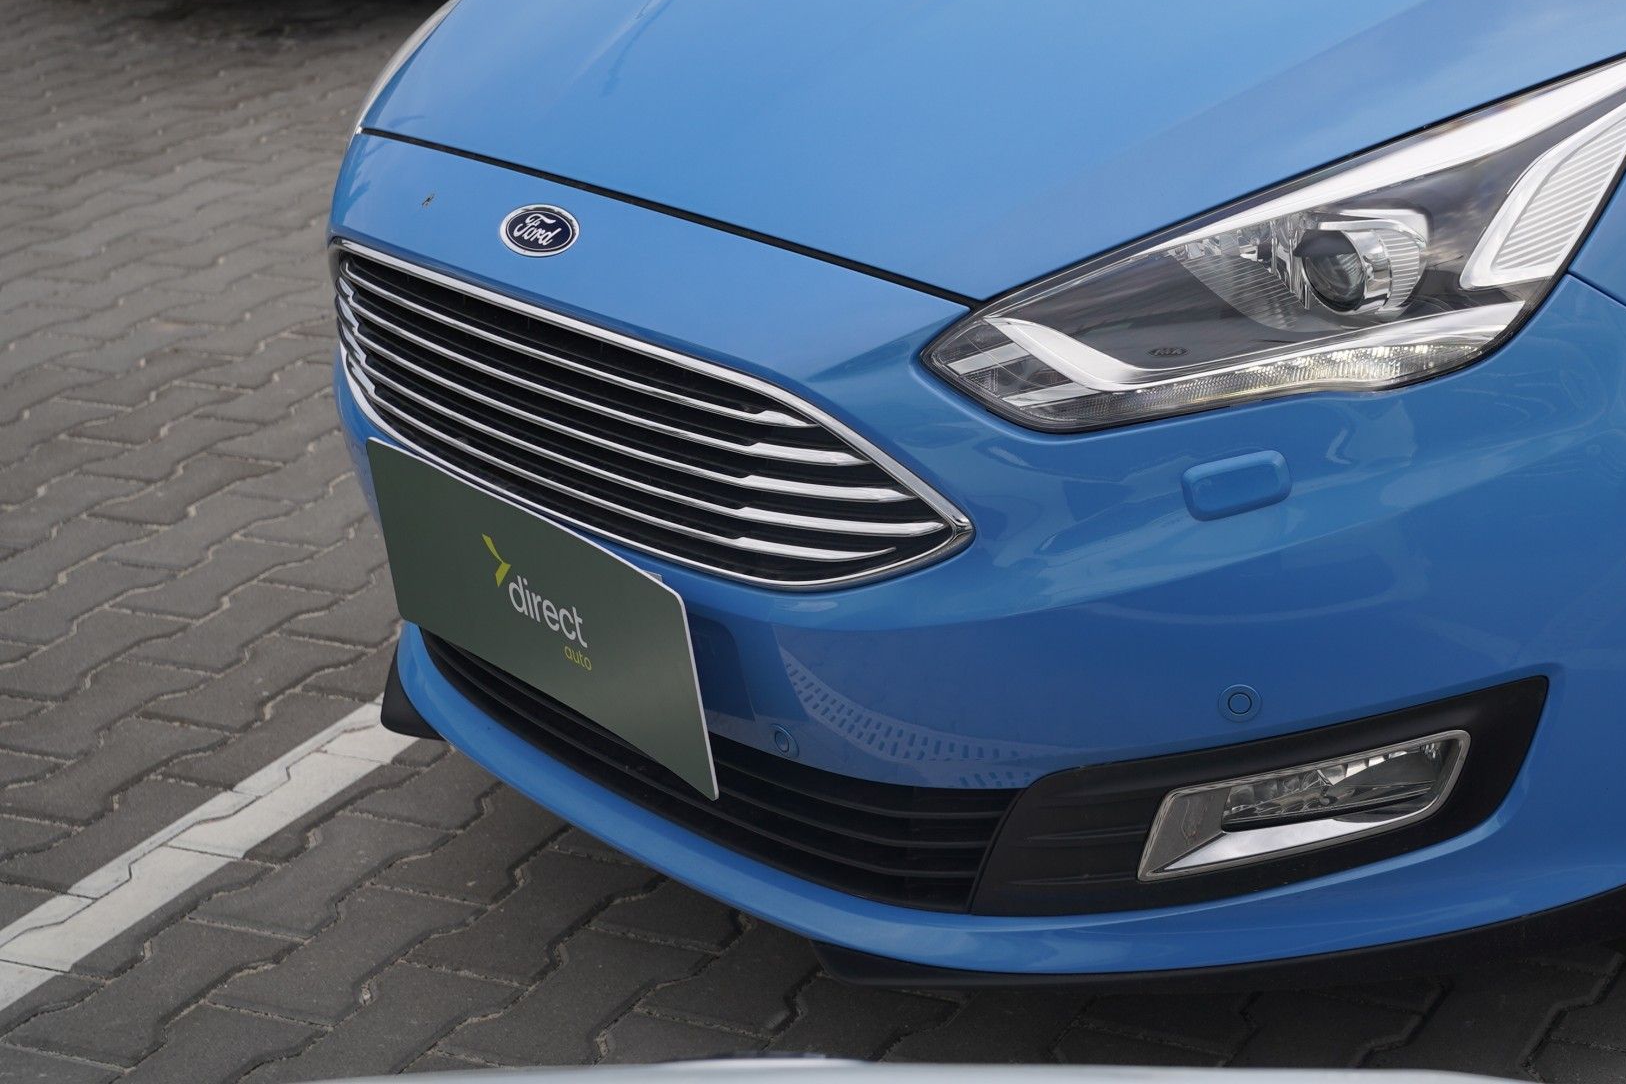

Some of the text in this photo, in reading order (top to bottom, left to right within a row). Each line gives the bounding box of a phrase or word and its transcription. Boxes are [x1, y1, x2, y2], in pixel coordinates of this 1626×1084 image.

[513, 213, 562, 246] Ford
[508, 575, 588, 648] direct
[564, 646, 592, 671] auto
